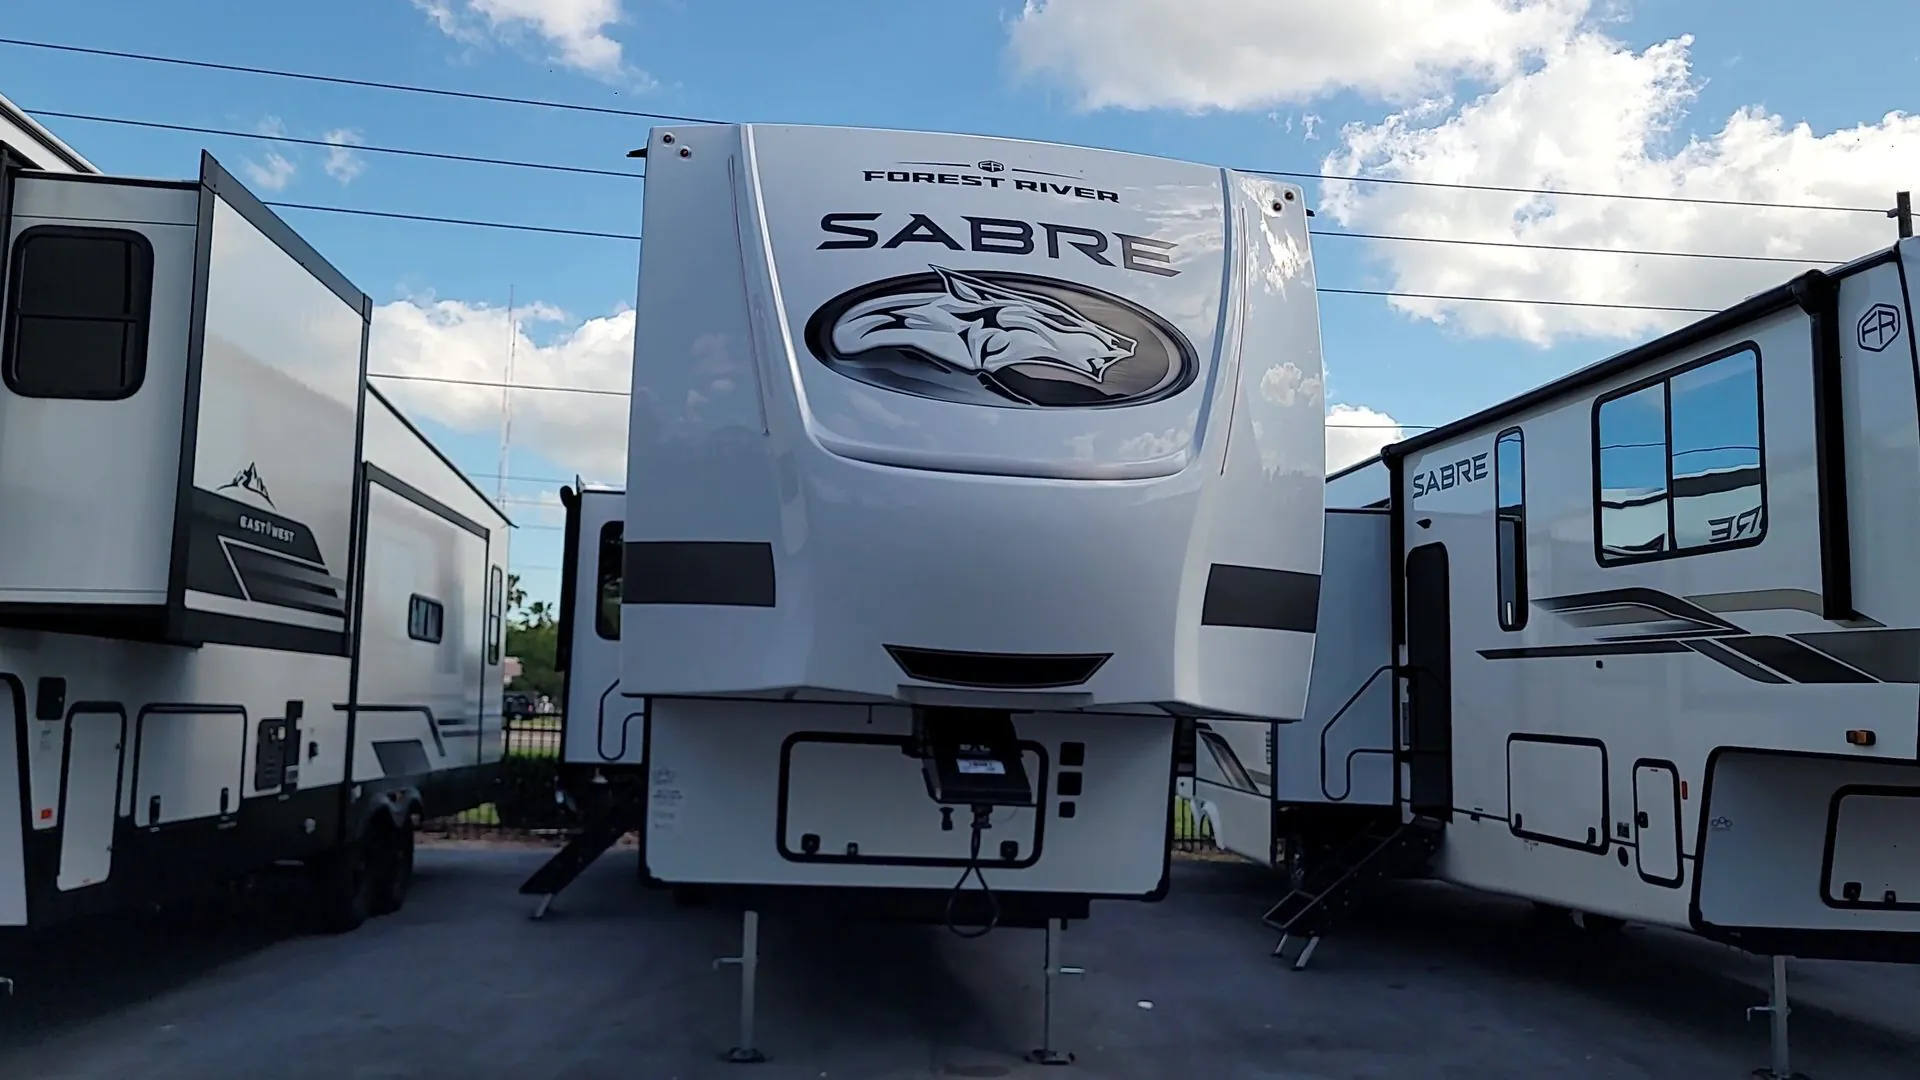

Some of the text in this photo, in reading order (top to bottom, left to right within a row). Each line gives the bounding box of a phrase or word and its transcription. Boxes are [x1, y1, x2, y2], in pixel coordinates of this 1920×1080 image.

[862, 170, 1120, 203] FOREST RIVER
[815, 212, 1182, 278] SABRE
[1412, 452, 1488, 499] SABRE
[240, 515, 266, 534] EAST
[271, 525, 295, 543] WEST
